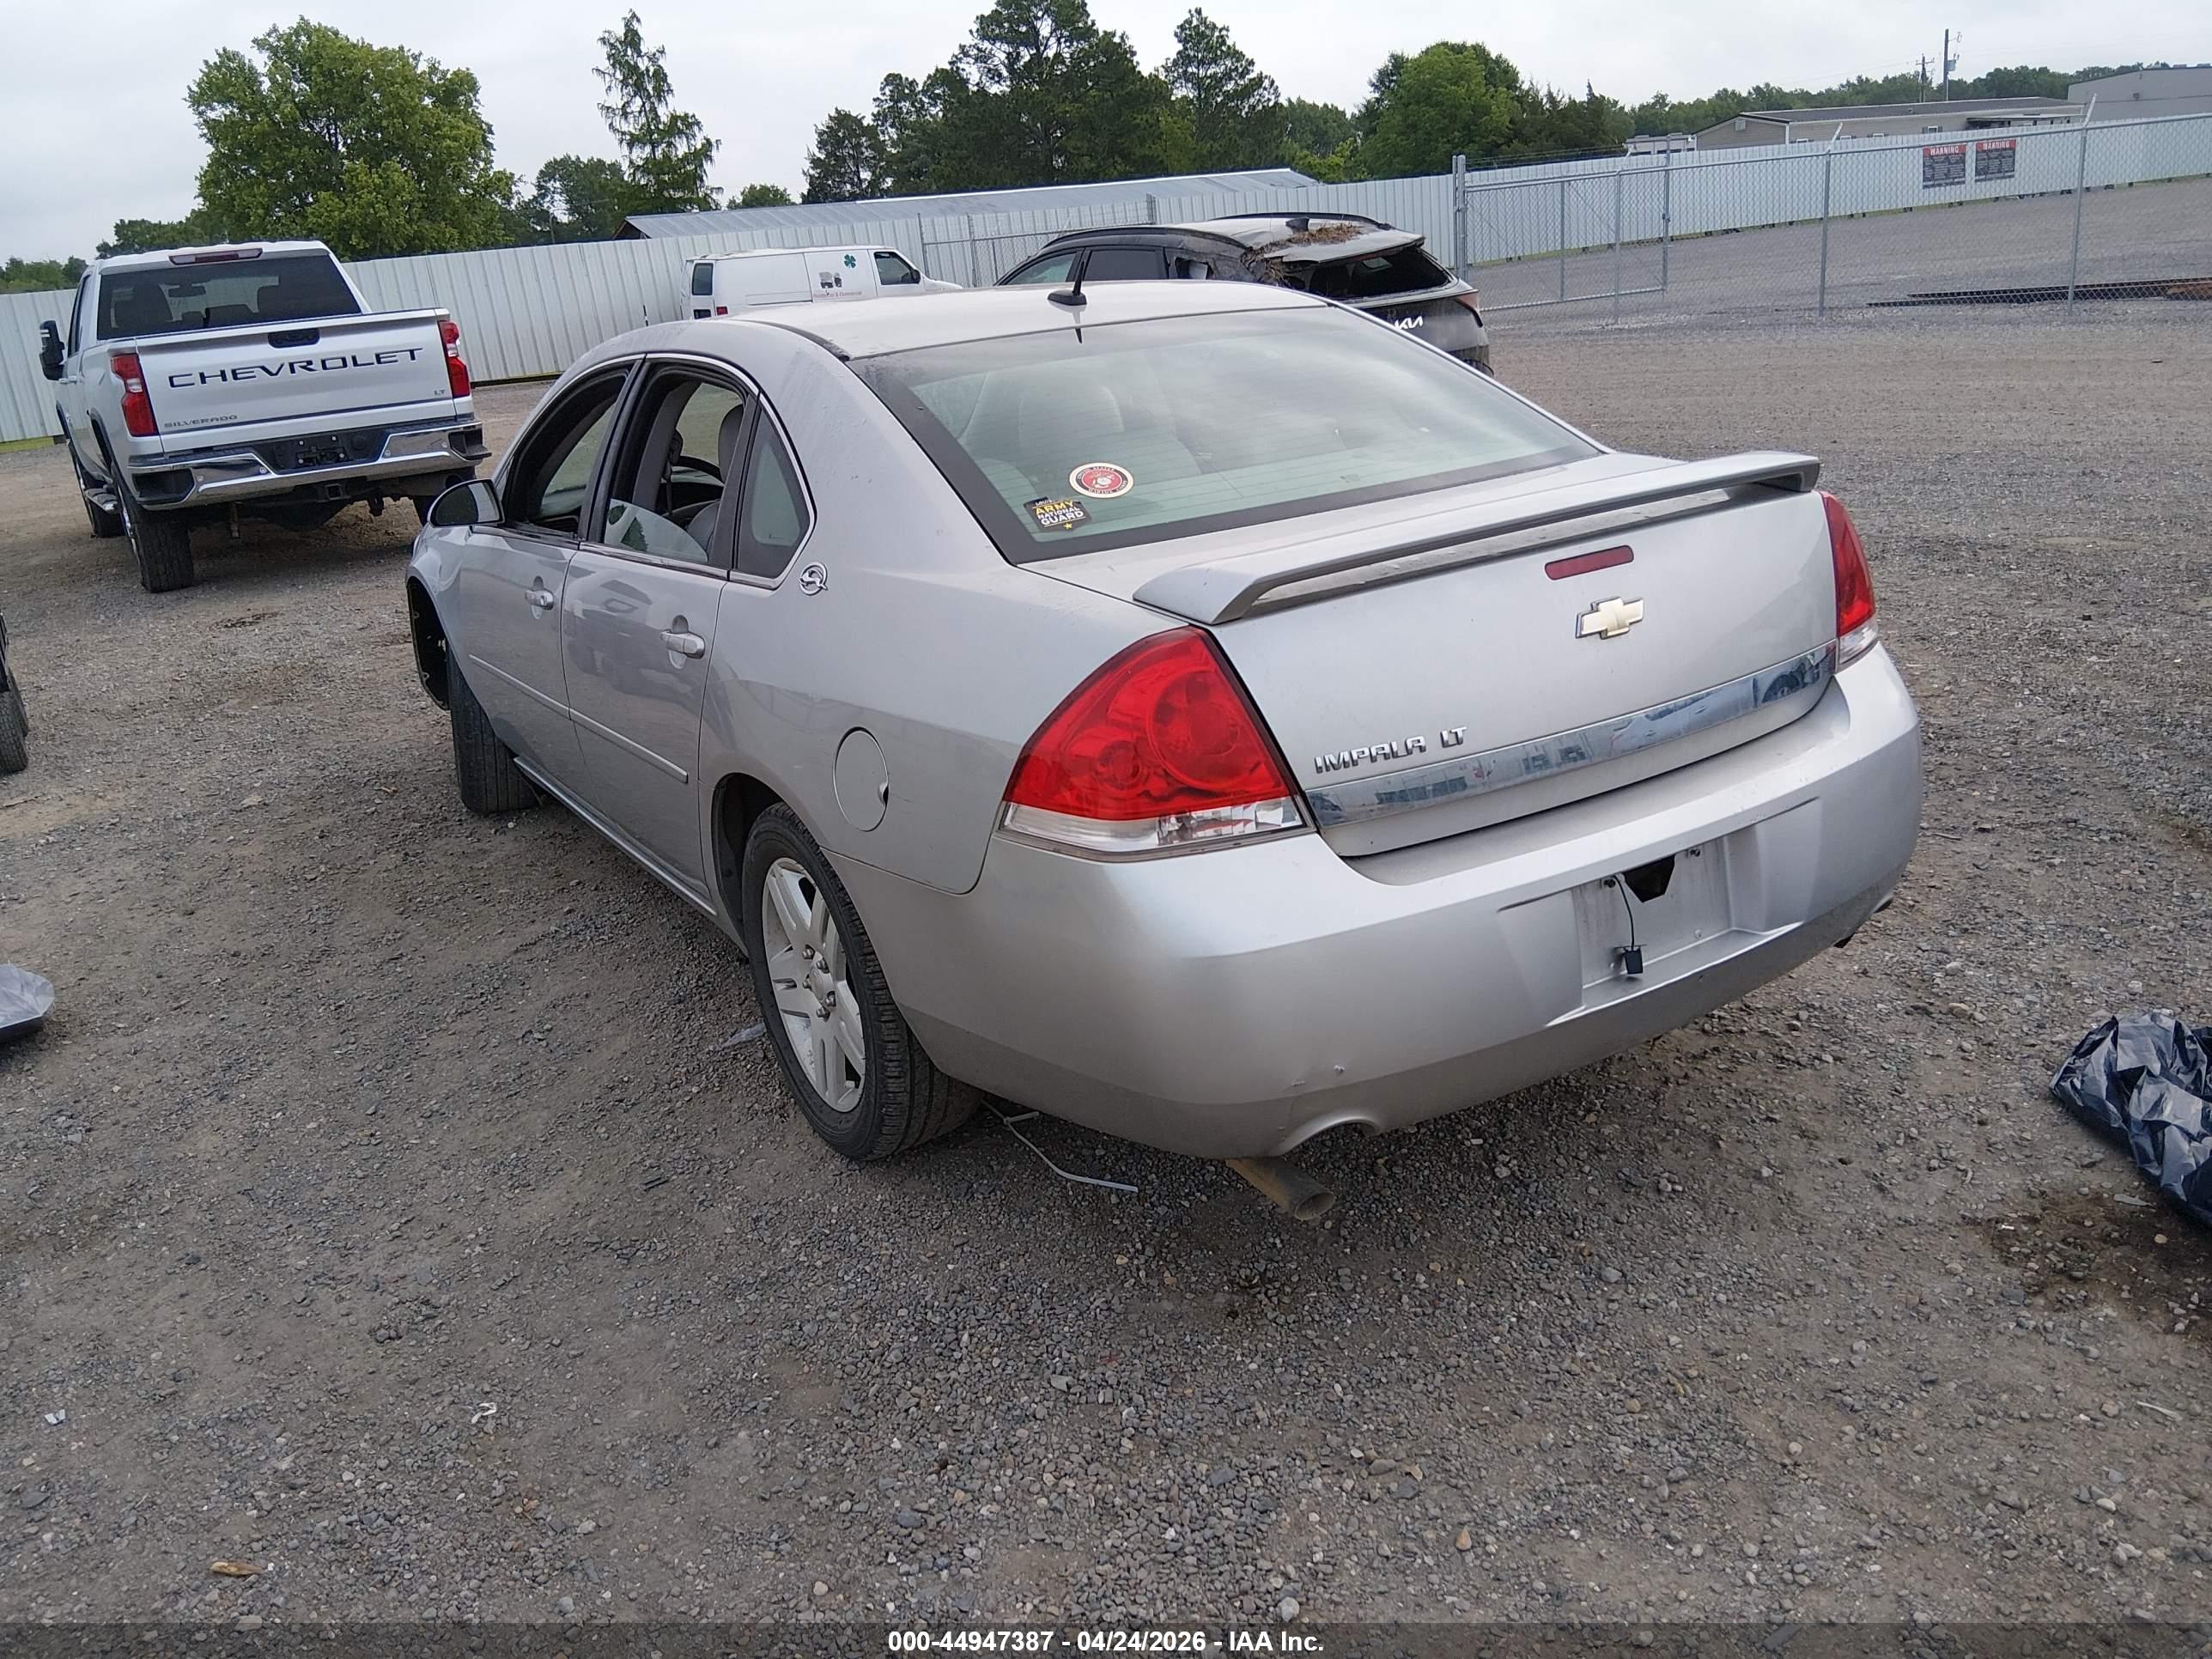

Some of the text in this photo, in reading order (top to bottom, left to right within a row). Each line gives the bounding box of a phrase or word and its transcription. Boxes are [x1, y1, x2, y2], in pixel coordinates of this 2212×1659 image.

[1929, 146, 1959, 155] WARNING
[1983, 141, 2010, 150] WARNING
[168, 347, 423, 388] CHEVROLET
[164, 414, 239, 428] SILVERADO
[1036, 500, 1073, 515] ARMY
[1037, 507, 1080, 520] NATIONAL
[1041, 510, 1085, 526] GUARD
[1315, 726, 1468, 774] IMPALA LT
